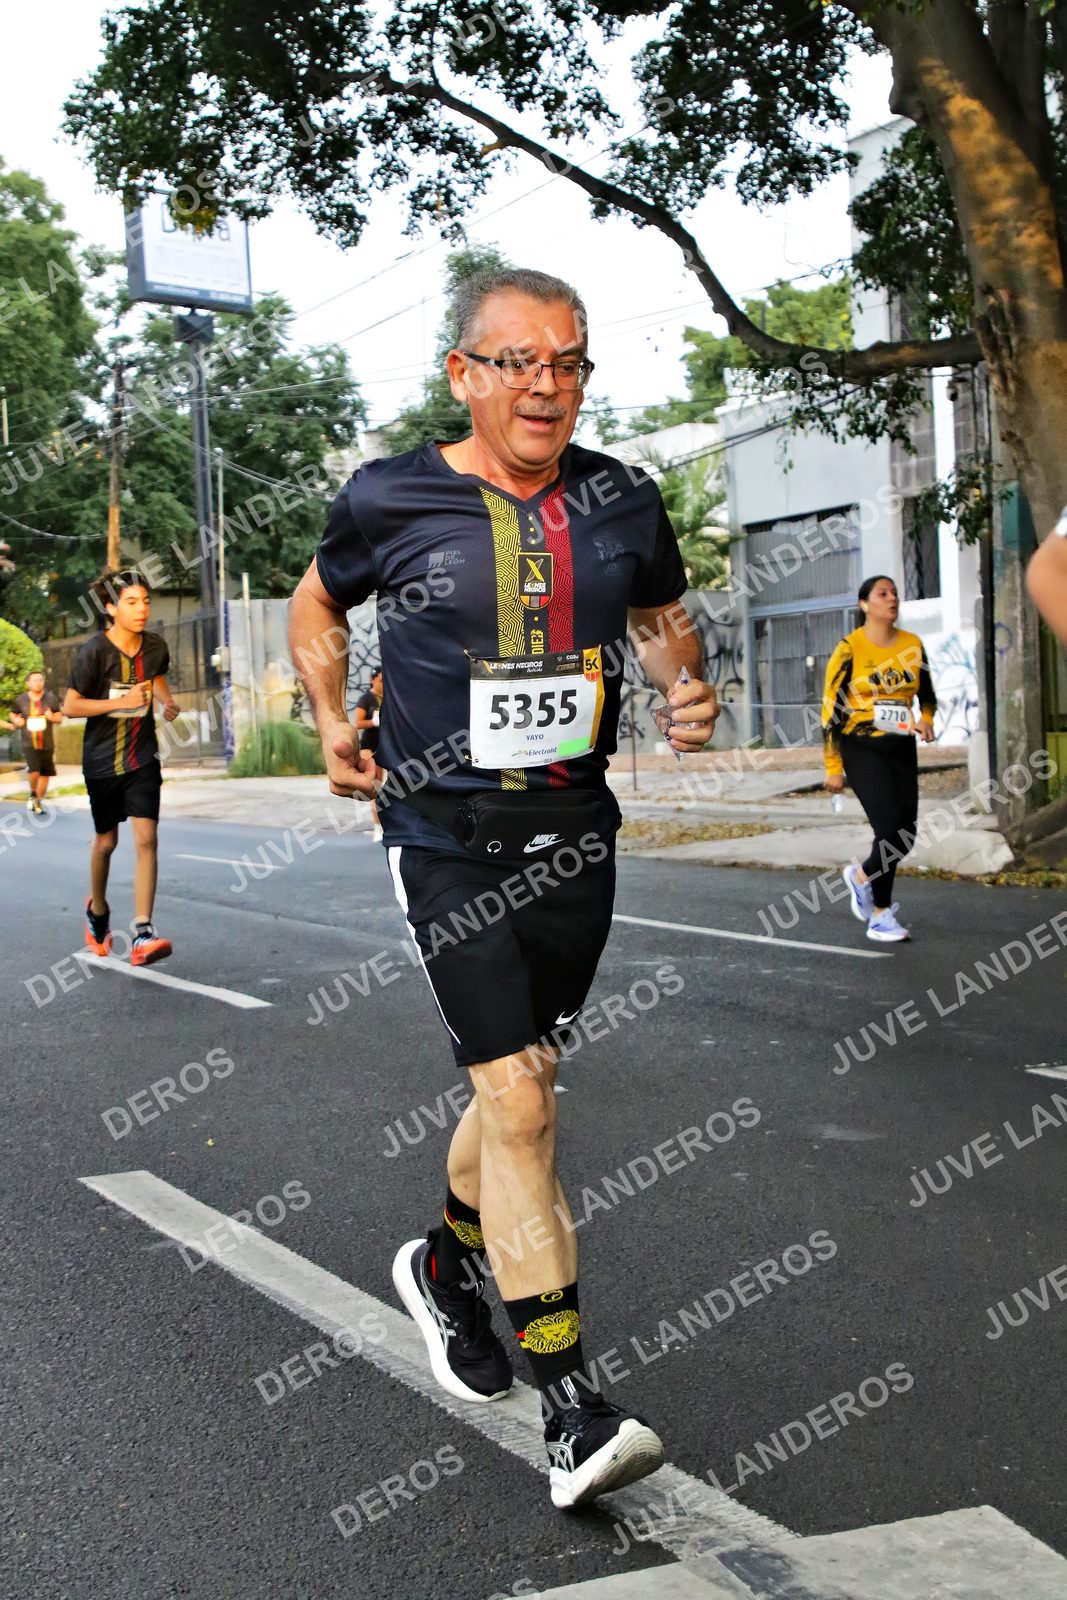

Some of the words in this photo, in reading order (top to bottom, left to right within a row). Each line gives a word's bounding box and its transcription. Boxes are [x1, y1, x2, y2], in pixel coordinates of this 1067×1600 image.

[489, 689, 578, 730] 5355
[880, 709, 906, 722] 2710
[526, 733, 544, 741] YAYO
[530, 834, 559, 845] NIKE
